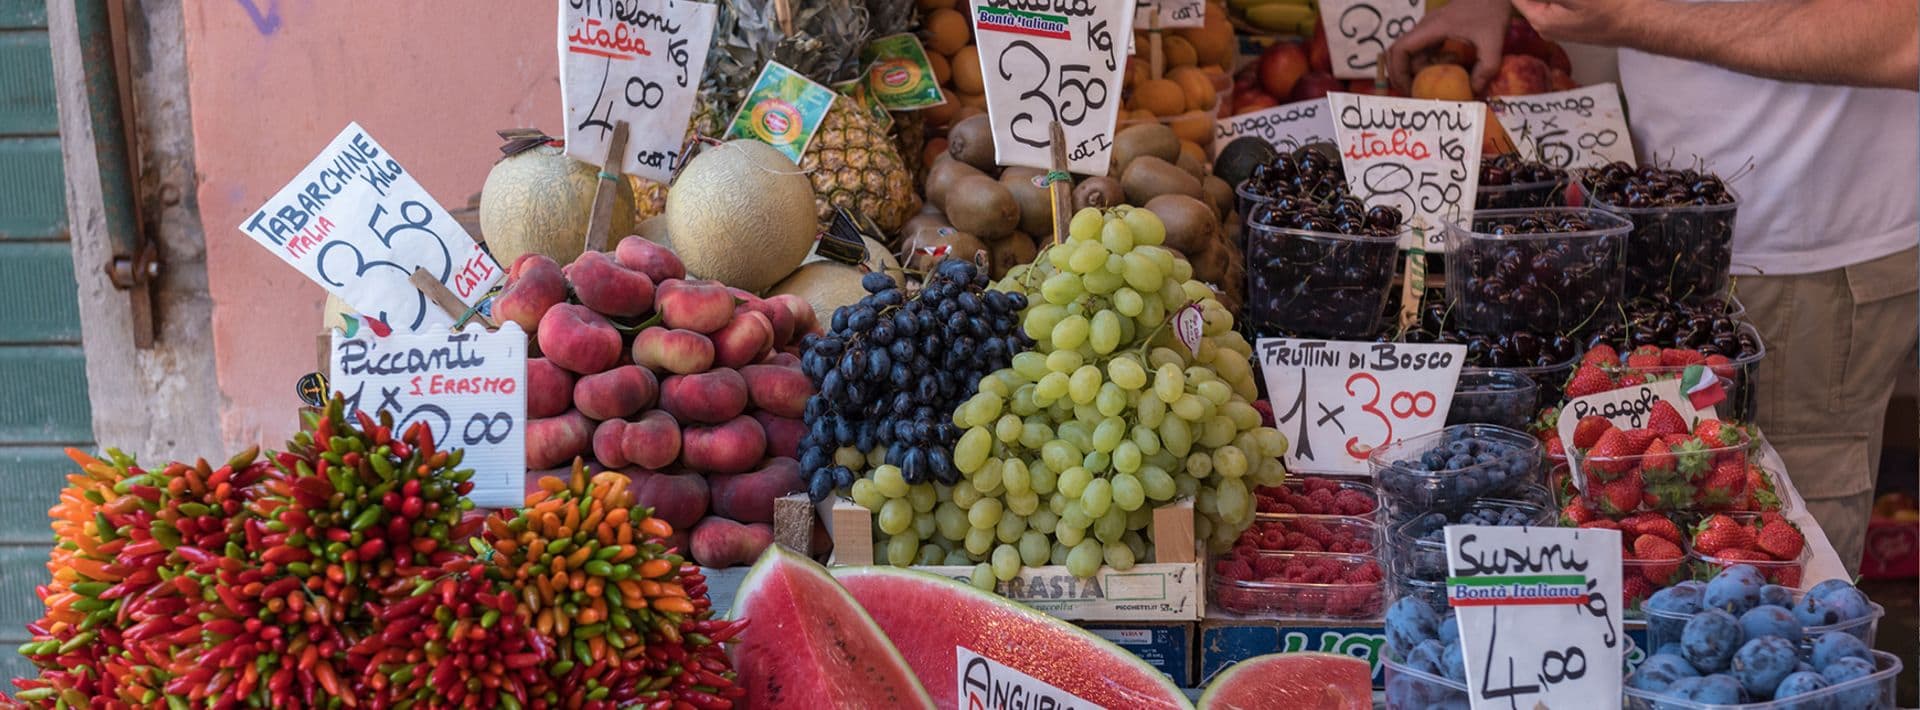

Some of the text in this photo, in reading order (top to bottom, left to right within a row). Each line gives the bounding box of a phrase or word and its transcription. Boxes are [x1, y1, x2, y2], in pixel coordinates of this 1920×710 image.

[569, 18, 652, 56] italia
[980, 11, 1064, 32] Bontà Italiana
[667, 39, 688, 88] Kg
[1088, 20, 1116, 71] Kg
[1341, 96, 1472, 131] duroni
[1344, 128, 1467, 181] italia Kg
[247, 133, 379, 246] TABARCHINE
[286, 216, 336, 259] ITALIA
[338, 333, 484, 375] Piccanti
[1263, 340, 1340, 367] FRUTTINI
[430, 374, 516, 395] ERASMO
[1456, 584, 1579, 598] Bontà Italiana
